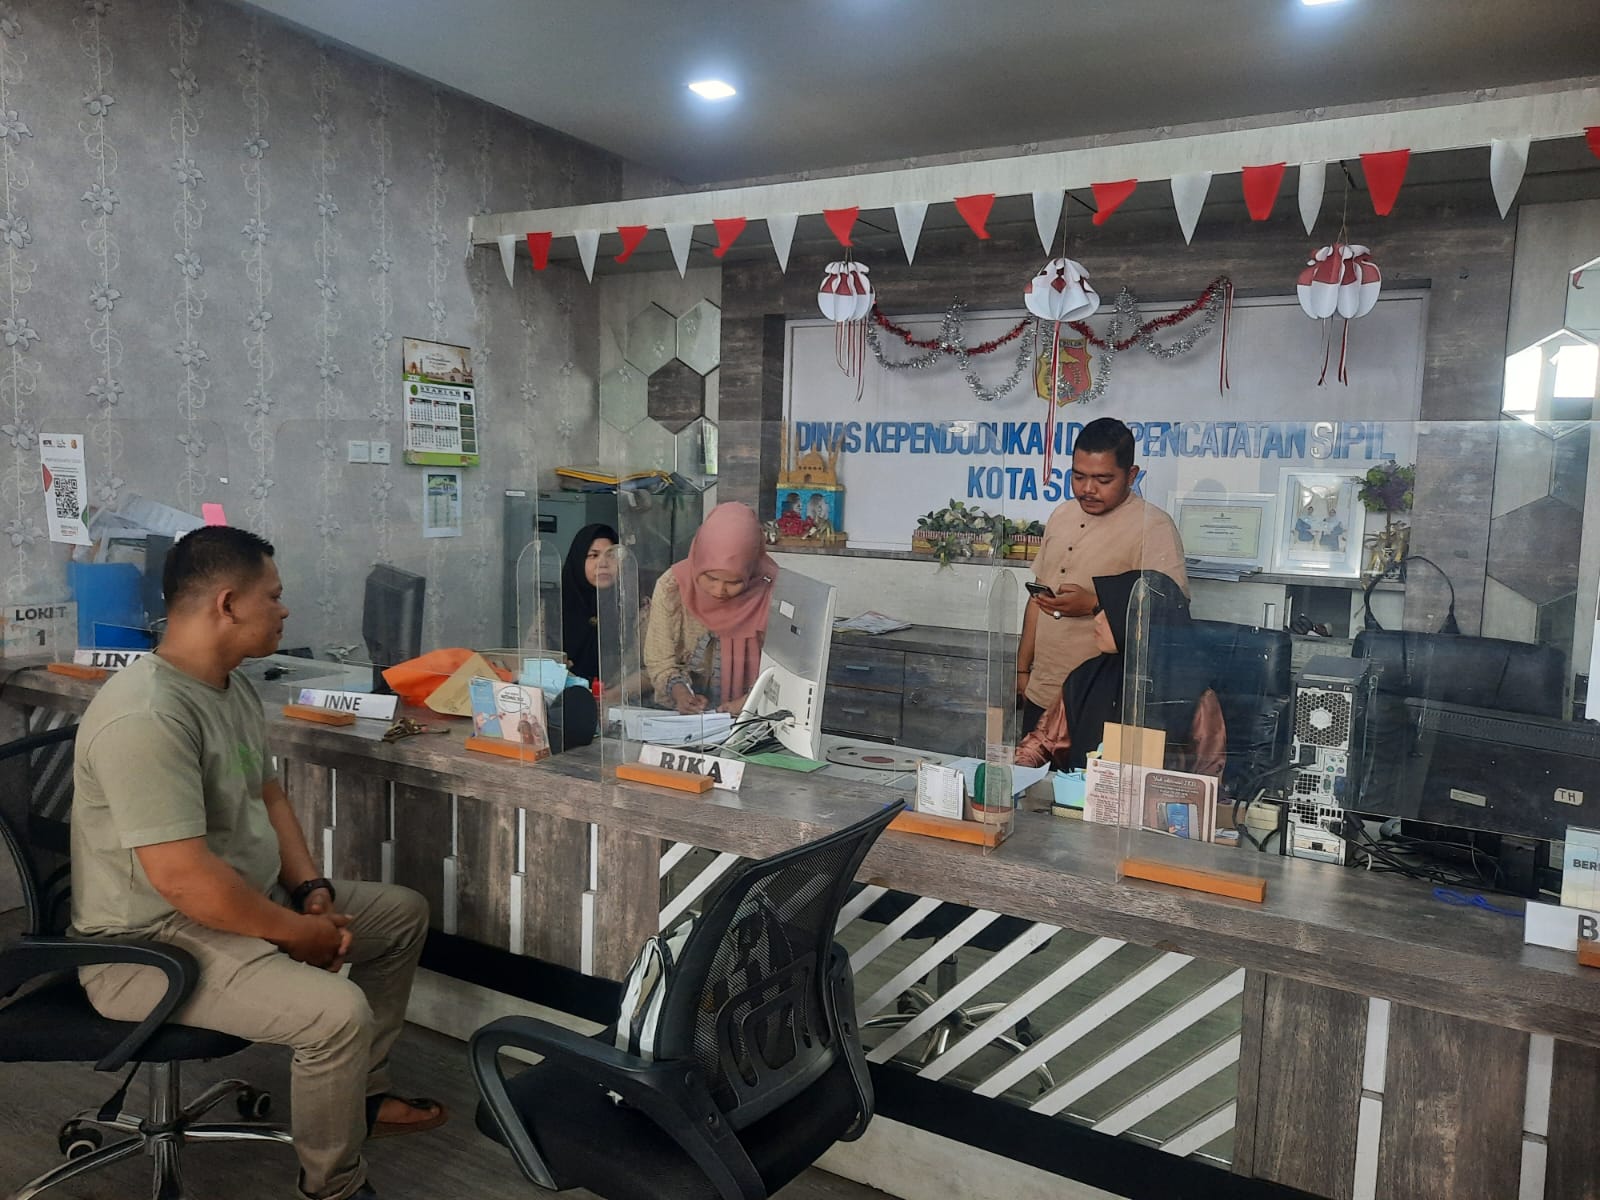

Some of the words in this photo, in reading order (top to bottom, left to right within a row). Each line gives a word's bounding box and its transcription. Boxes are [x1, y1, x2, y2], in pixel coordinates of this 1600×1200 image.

[796, 421, 861, 453] DINAS
[865, 421, 1062, 455] KEPENDUDUKAN
[1126, 420, 1305, 459] PENCATATAN
[1310, 421, 1396, 459] SIPIL
[967, 466, 1038, 501] KOTA
[36, 629, 46, 646] 1
[323, 693, 362, 712] INNE
[659, 751, 723, 784] RIKA
